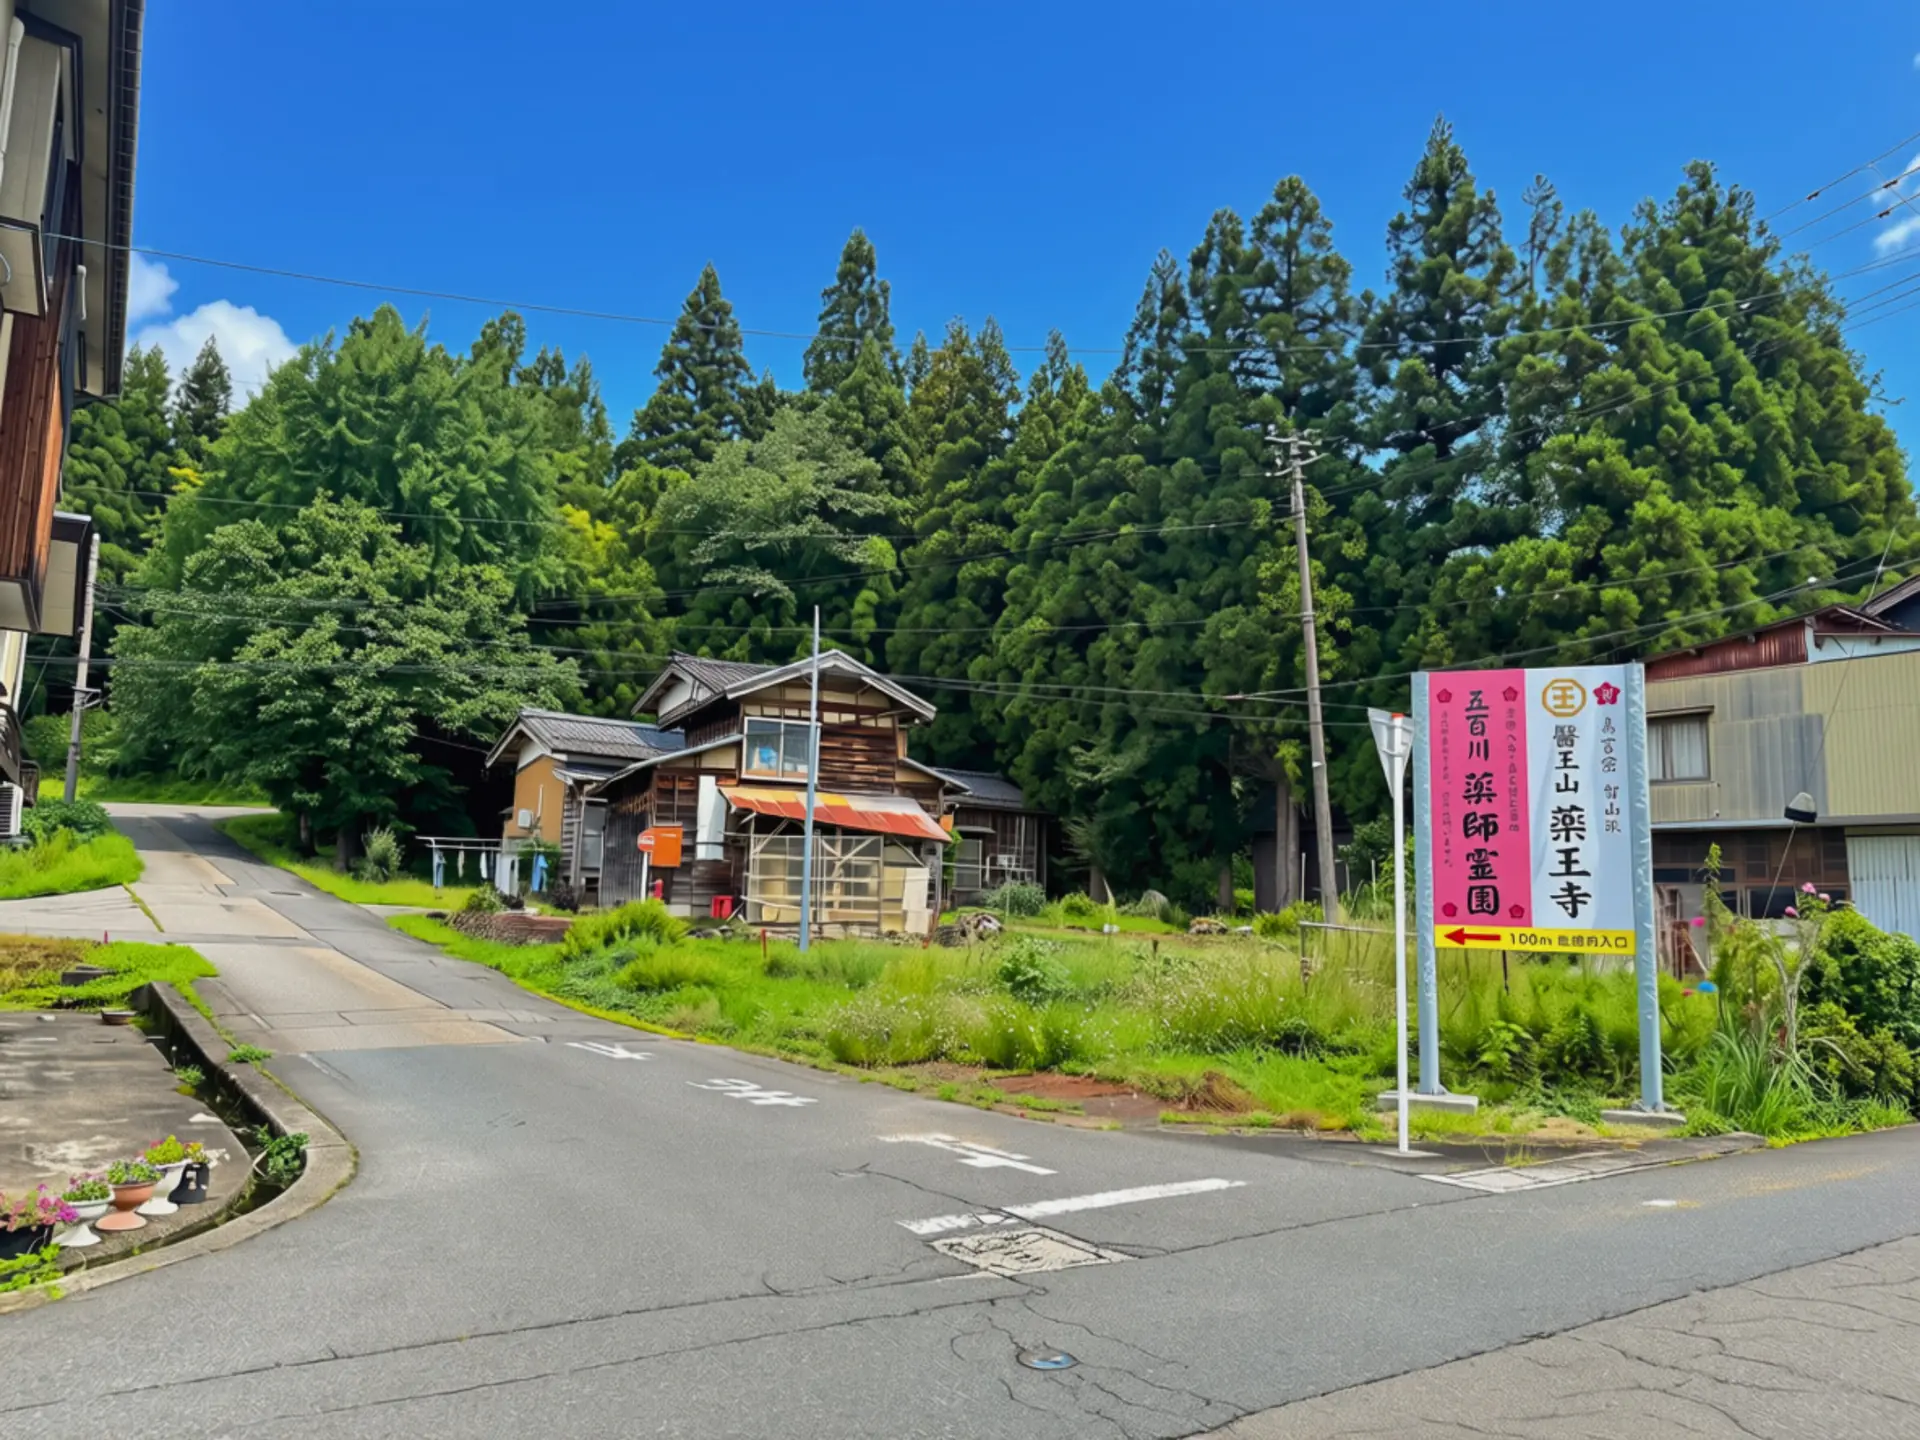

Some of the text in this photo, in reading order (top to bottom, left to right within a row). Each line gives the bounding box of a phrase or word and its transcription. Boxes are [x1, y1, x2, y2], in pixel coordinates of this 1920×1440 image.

[1465, 690, 1489, 761] 五百川
[1548, 804, 1592, 919] 薬王寺
[1510, 932, 1553, 946] 100m
